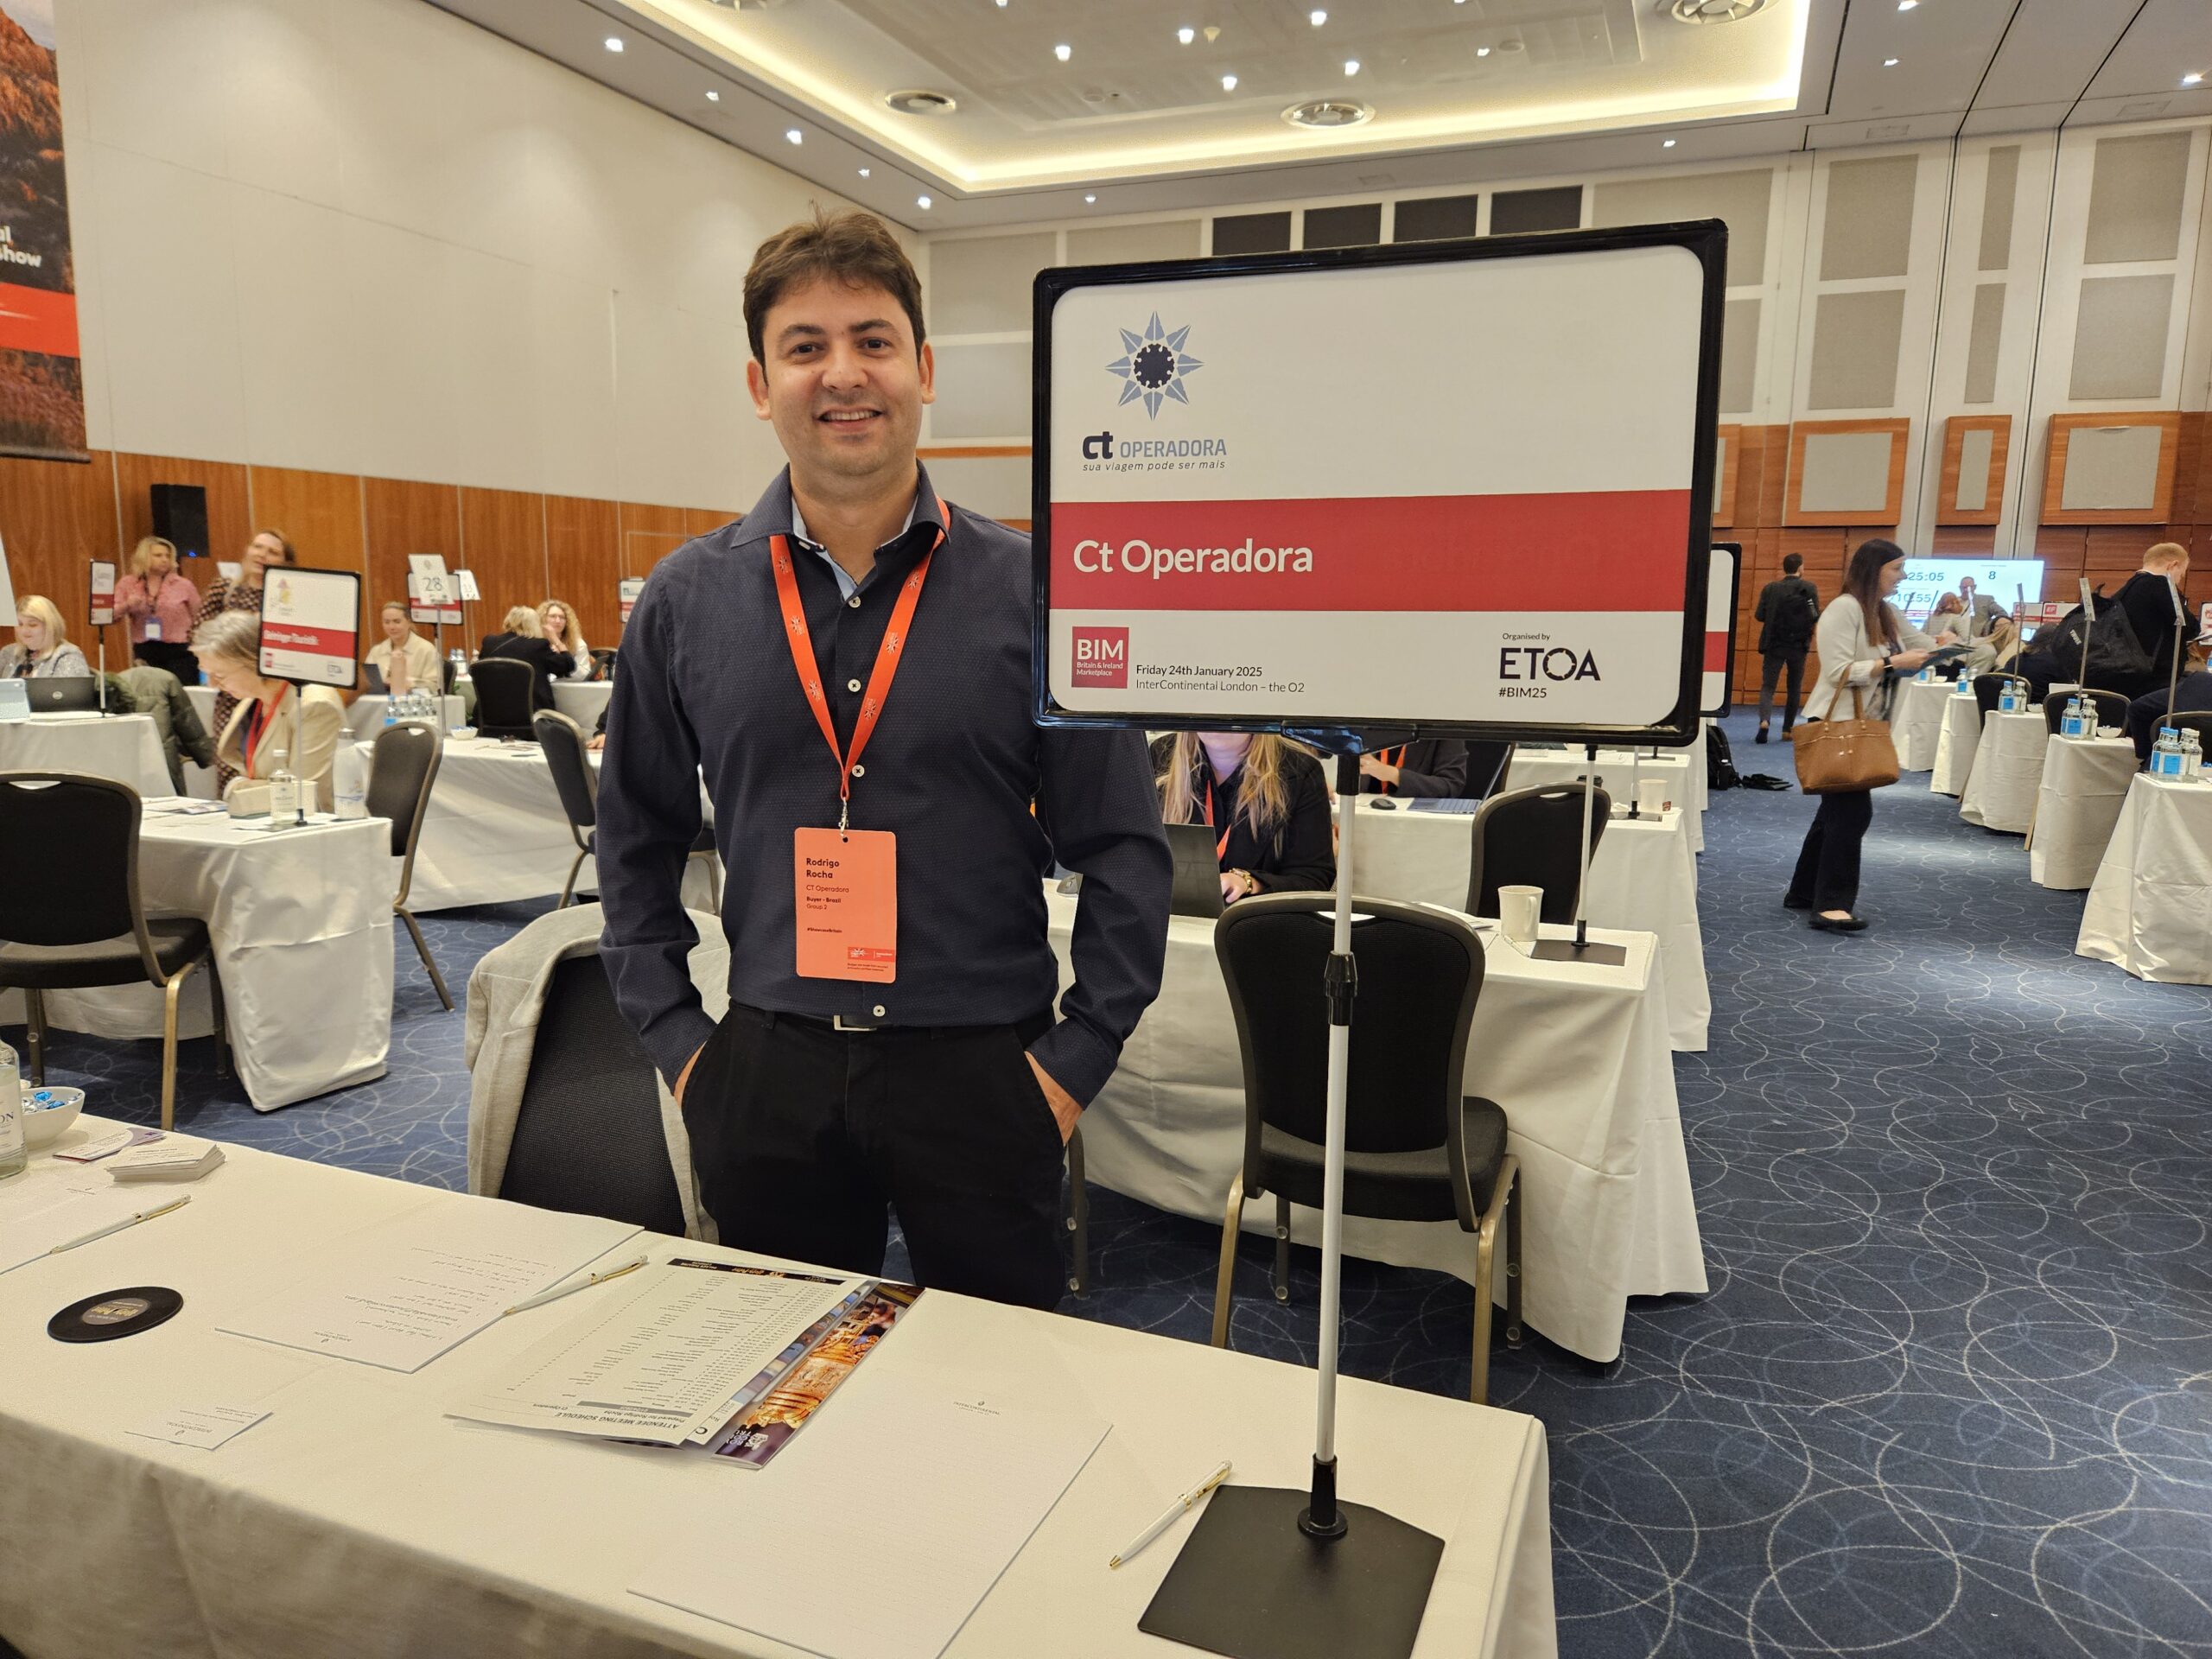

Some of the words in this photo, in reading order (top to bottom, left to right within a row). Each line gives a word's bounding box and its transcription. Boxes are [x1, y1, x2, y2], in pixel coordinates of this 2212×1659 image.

[1083, 431, 1113, 460] ct
[1120, 439, 1227, 458] OPERADORA
[1105, 462, 1143, 472] viagem
[1147, 461, 1174, 472] pode
[1179, 461, 1195, 470] ser
[1198, 460, 1225, 469] mais
[1073, 539, 1113, 573] Ct
[1122, 538, 1313, 580] Operadora
[1988, 570, 1996, 580] 8
[423, 576, 442, 591] 28
[1077, 639, 1123, 660] BIM
[1500, 647, 1600, 681] ETOA
[1136, 664, 1166, 677] Friday
[1168, 664, 1192, 676] 24th
[1194, 665, 1234, 677] January
[1236, 666, 1262, 677] 2025
[1136, 679, 1218, 691] InterContinental
[1220, 680, 1258, 691] London
[1268, 682, 1286, 692] the
[1288, 682, 1305, 692] O2
[1498, 687, 1547, 698] #BIM25
[806, 858, 840, 868] Rodrigo
[806, 869, 833, 879] Rocha
[816, 885, 849, 893] Operadora
[554, 1412, 598, 1421] SCHEDULE
[598, 1416, 635, 1425] MEETING
